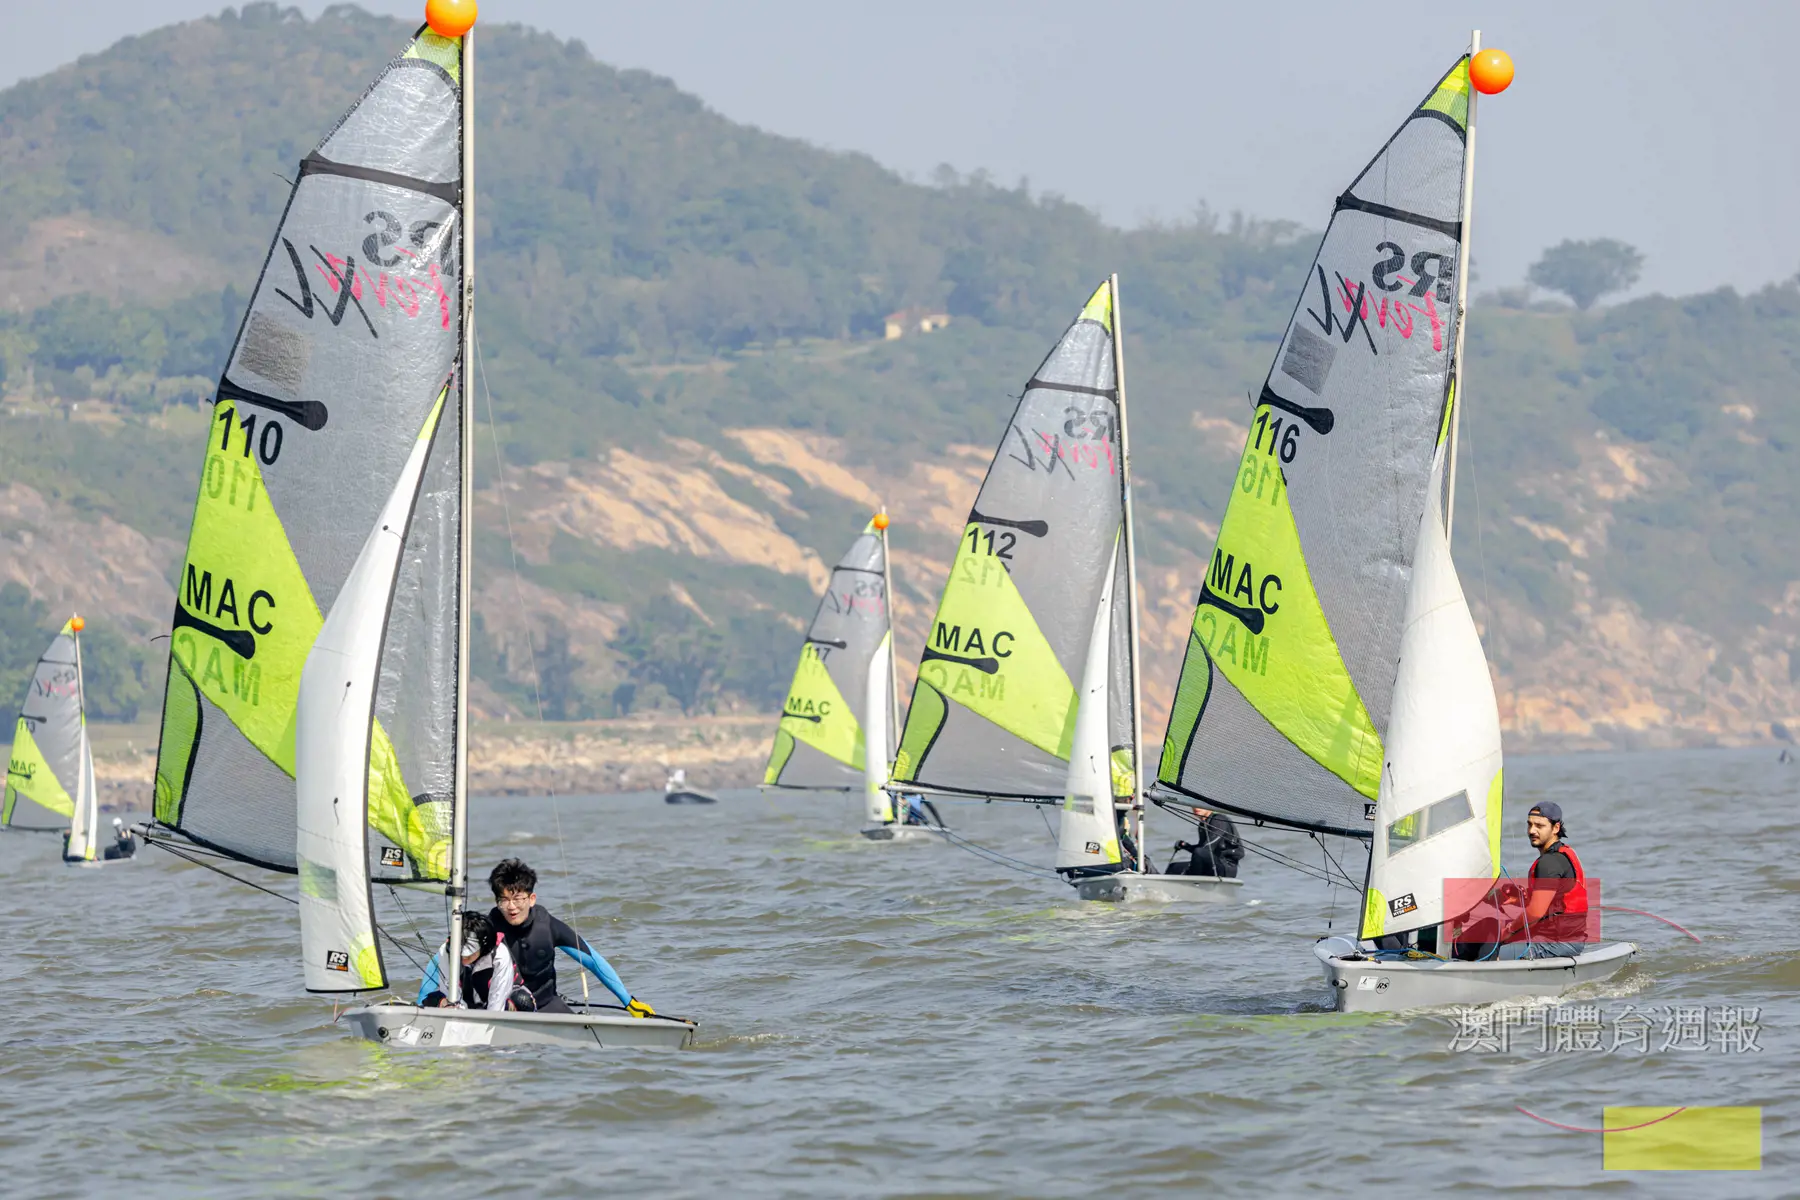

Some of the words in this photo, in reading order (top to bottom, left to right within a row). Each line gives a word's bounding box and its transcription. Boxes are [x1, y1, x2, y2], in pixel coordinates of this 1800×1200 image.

[219, 406, 283, 466] 110
[1254, 411, 1300, 464] 116
[967, 527, 1017, 560] 112
[1211, 547, 1283, 615] MAC
[187, 563, 276, 635] MAC
[936, 621, 1015, 658] MAC
[806, 646, 832, 662] 117
[788, 696, 832, 716] MAC
[11, 760, 37, 775] MAC
[384, 848, 402, 859] RS
[1087, 842, 1099, 850] RS
[1394, 895, 1413, 910] RS
[329, 952, 347, 963] RS
[421, 1031, 434, 1040] RS
